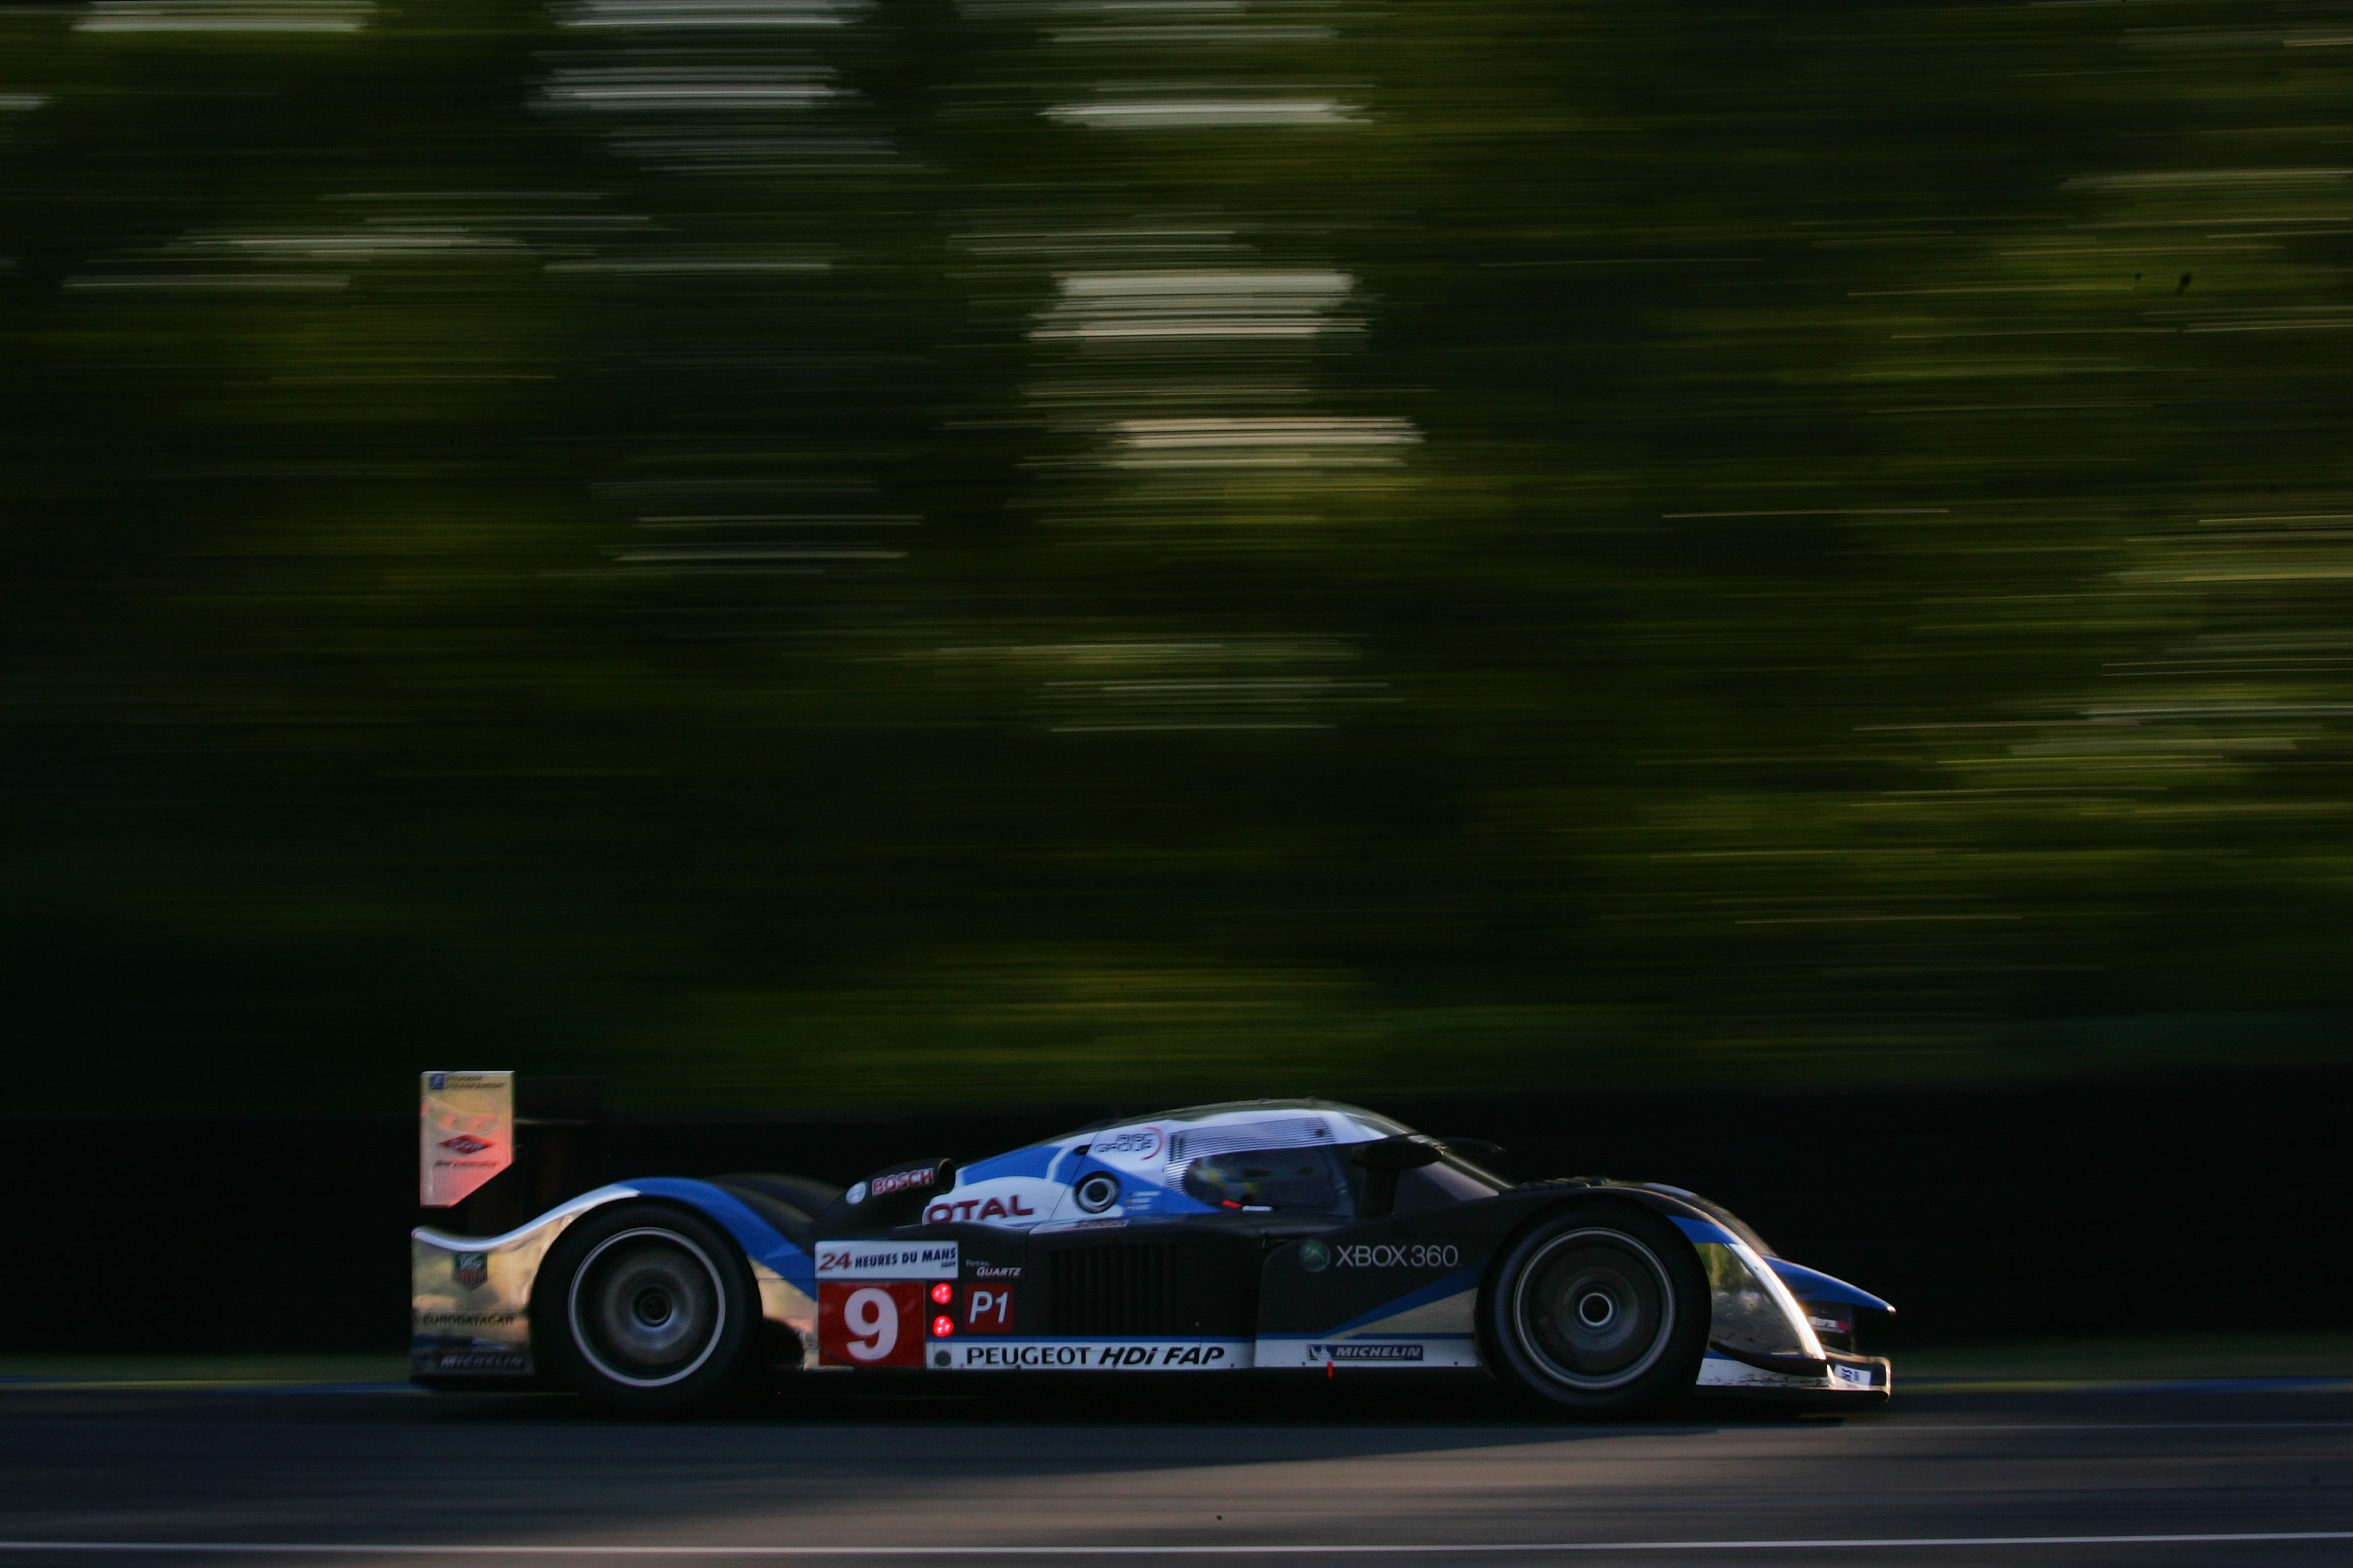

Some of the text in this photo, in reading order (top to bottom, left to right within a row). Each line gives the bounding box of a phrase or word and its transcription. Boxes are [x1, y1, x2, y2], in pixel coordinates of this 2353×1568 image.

[872, 1168, 934, 1196] BOSCH
[928, 1195, 1034, 1225] OTAL
[818, 1247, 957, 1270] 24 HEURES DU MANS
[1335, 1245, 1458, 1267] XBOX 360
[976, 1266, 1021, 1278] QUARTZ
[969, 1291, 1008, 1324] P1
[844, 1288, 899, 1360] 9
[440, 1355, 524, 1368] MICHELIN
[966, 1347, 1224, 1364] PEUGEOT HDi FAP
[1335, 1346, 1421, 1357] MICHELIN
